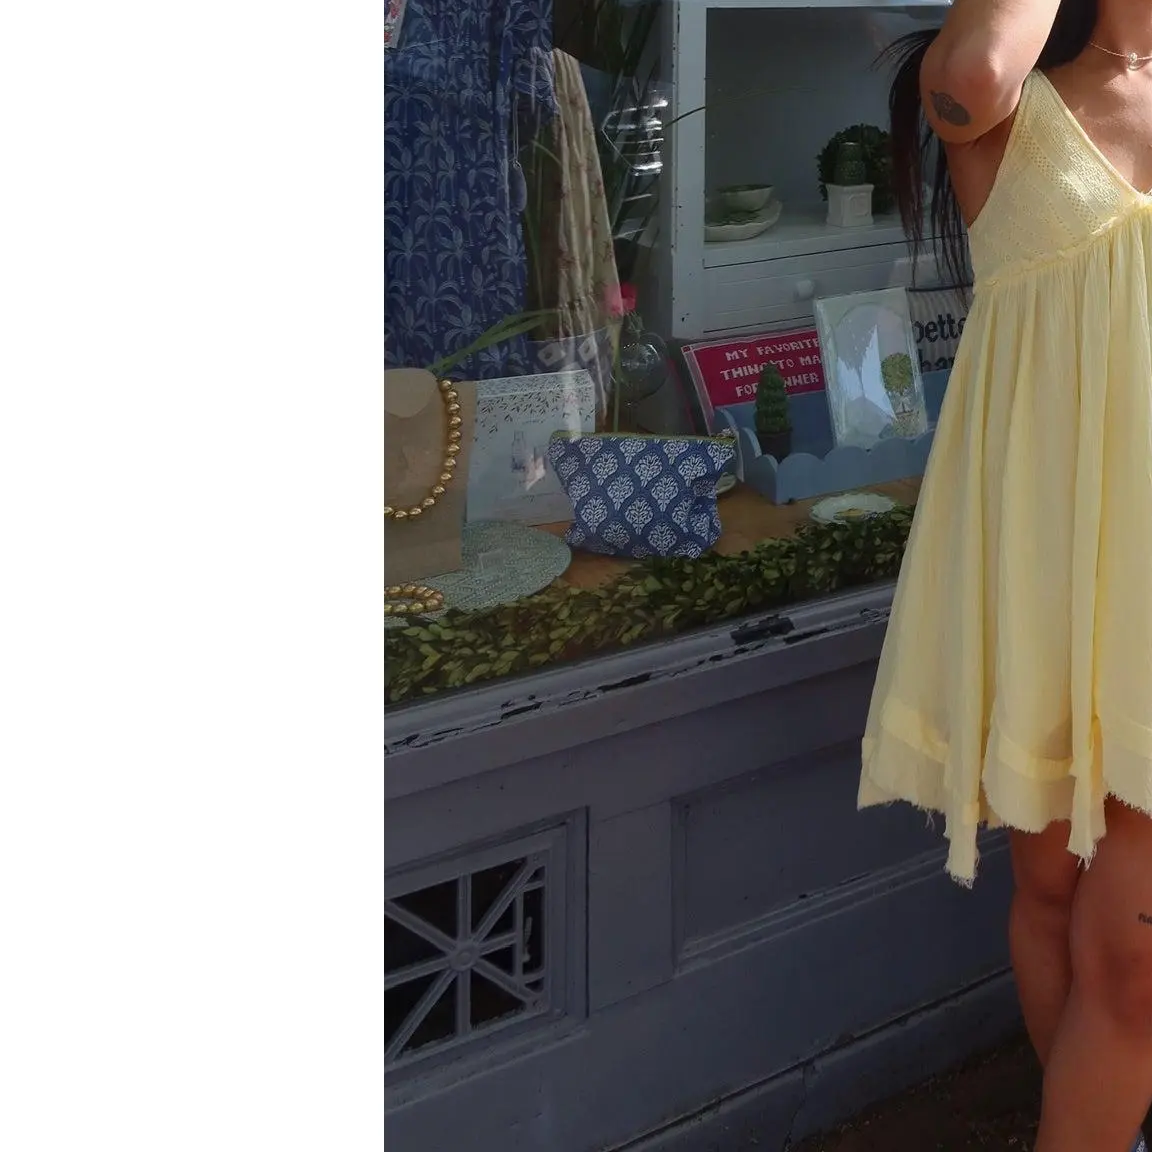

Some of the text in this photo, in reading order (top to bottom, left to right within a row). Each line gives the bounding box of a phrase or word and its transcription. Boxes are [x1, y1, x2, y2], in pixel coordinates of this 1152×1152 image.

[725, 348, 748, 361] MY
[775, 358, 795, 370] TO
[799, 354, 821, 366] MA
[783, 372, 819, 388] NNER
